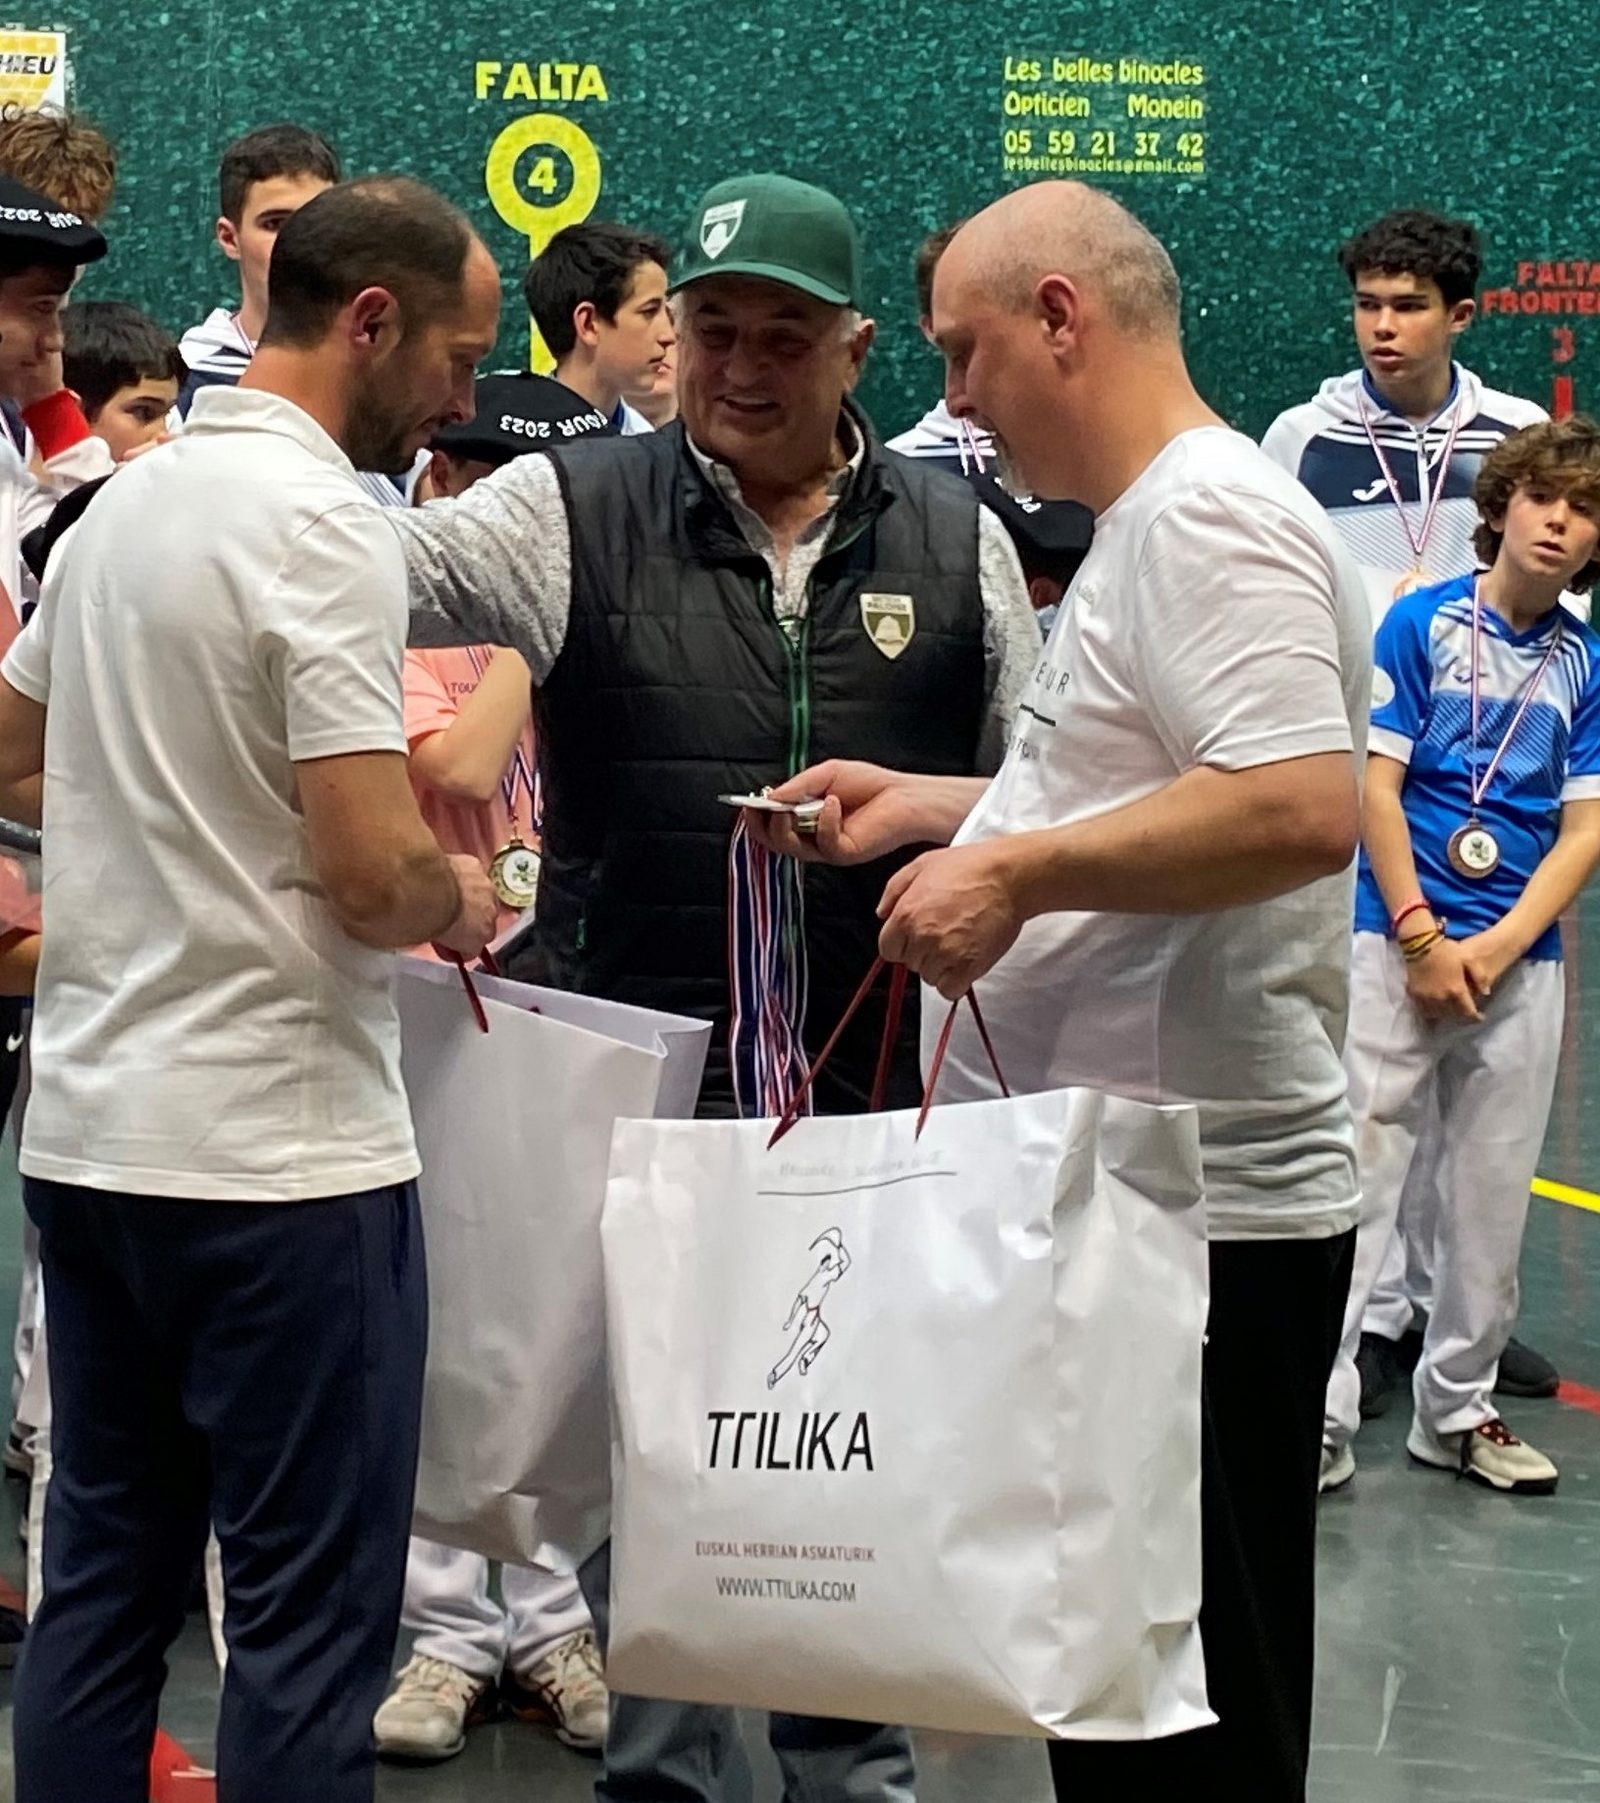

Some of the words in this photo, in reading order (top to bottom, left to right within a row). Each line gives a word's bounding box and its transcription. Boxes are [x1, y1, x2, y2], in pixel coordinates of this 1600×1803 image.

[476, 61, 609, 101] FALTA
[1004, 56, 1042, 81] Les
[1053, 57, 1114, 82] belles
[1119, 59, 1203, 85] binocles
[1004, 90, 1090, 116] Opticien
[1128, 94, 1203, 119] Monein
[1004, 129, 1032, 154] 05
[1048, 130, 1075, 155] 59
[1091, 131, 1115, 156] 21
[1134, 132, 1160, 156] 37
[1176, 133, 1204, 157] 42
[528, 157, 557, 195] 4
[1517, 261, 1600, 287] FALTA
[1481, 289, 1600, 315] FRONTE
[1552, 326, 1575, 363] 3
[500, 414, 551, 438] 2023
[707, 1411, 874, 1472] TTILIKA
[695, 1540, 741, 1558] EUSKAL
[743, 1542, 798, 1560] HERRIAN
[801, 1545, 877, 1562] ASMATURIK
[716, 1576, 857, 1603] WWW.TTILIKA.COM
